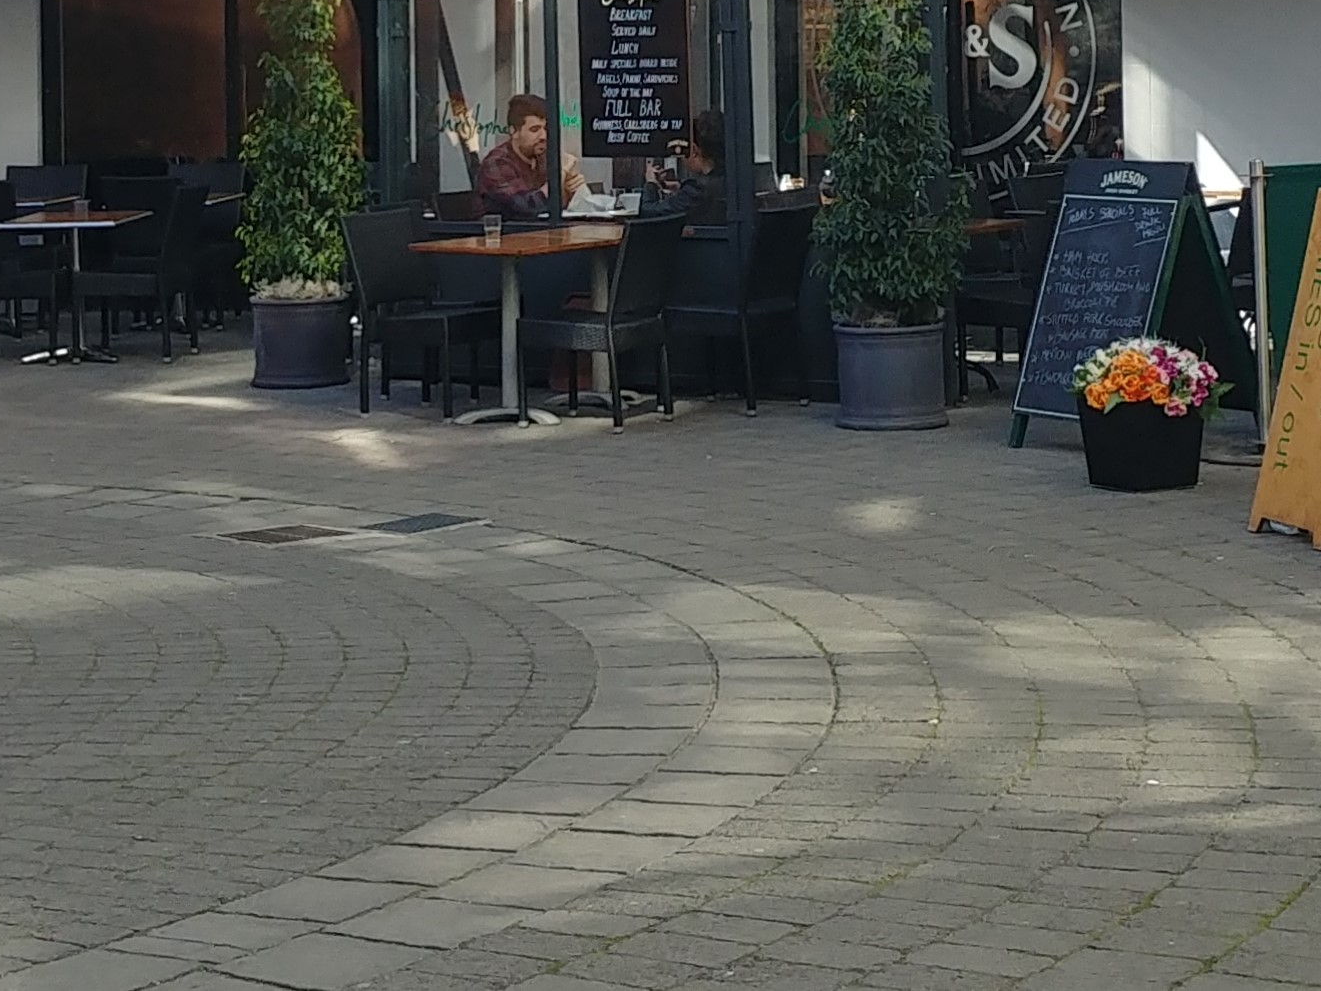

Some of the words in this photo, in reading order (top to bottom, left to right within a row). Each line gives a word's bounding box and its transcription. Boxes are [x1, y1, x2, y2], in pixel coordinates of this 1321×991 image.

[609, 7, 653, 22] BREAKFAST
[611, 40, 640, 55] LUNCH
[605, 99, 632, 117] FULL
[639, 98, 662, 117] BAR
[626, 130, 650, 143] COFFEE
[976, 77, 1080, 186] IMITED
[1100, 170, 1149, 189] JAMESON
[1294, 341, 1315, 372] in
[1273, 410, 1295, 471] out
